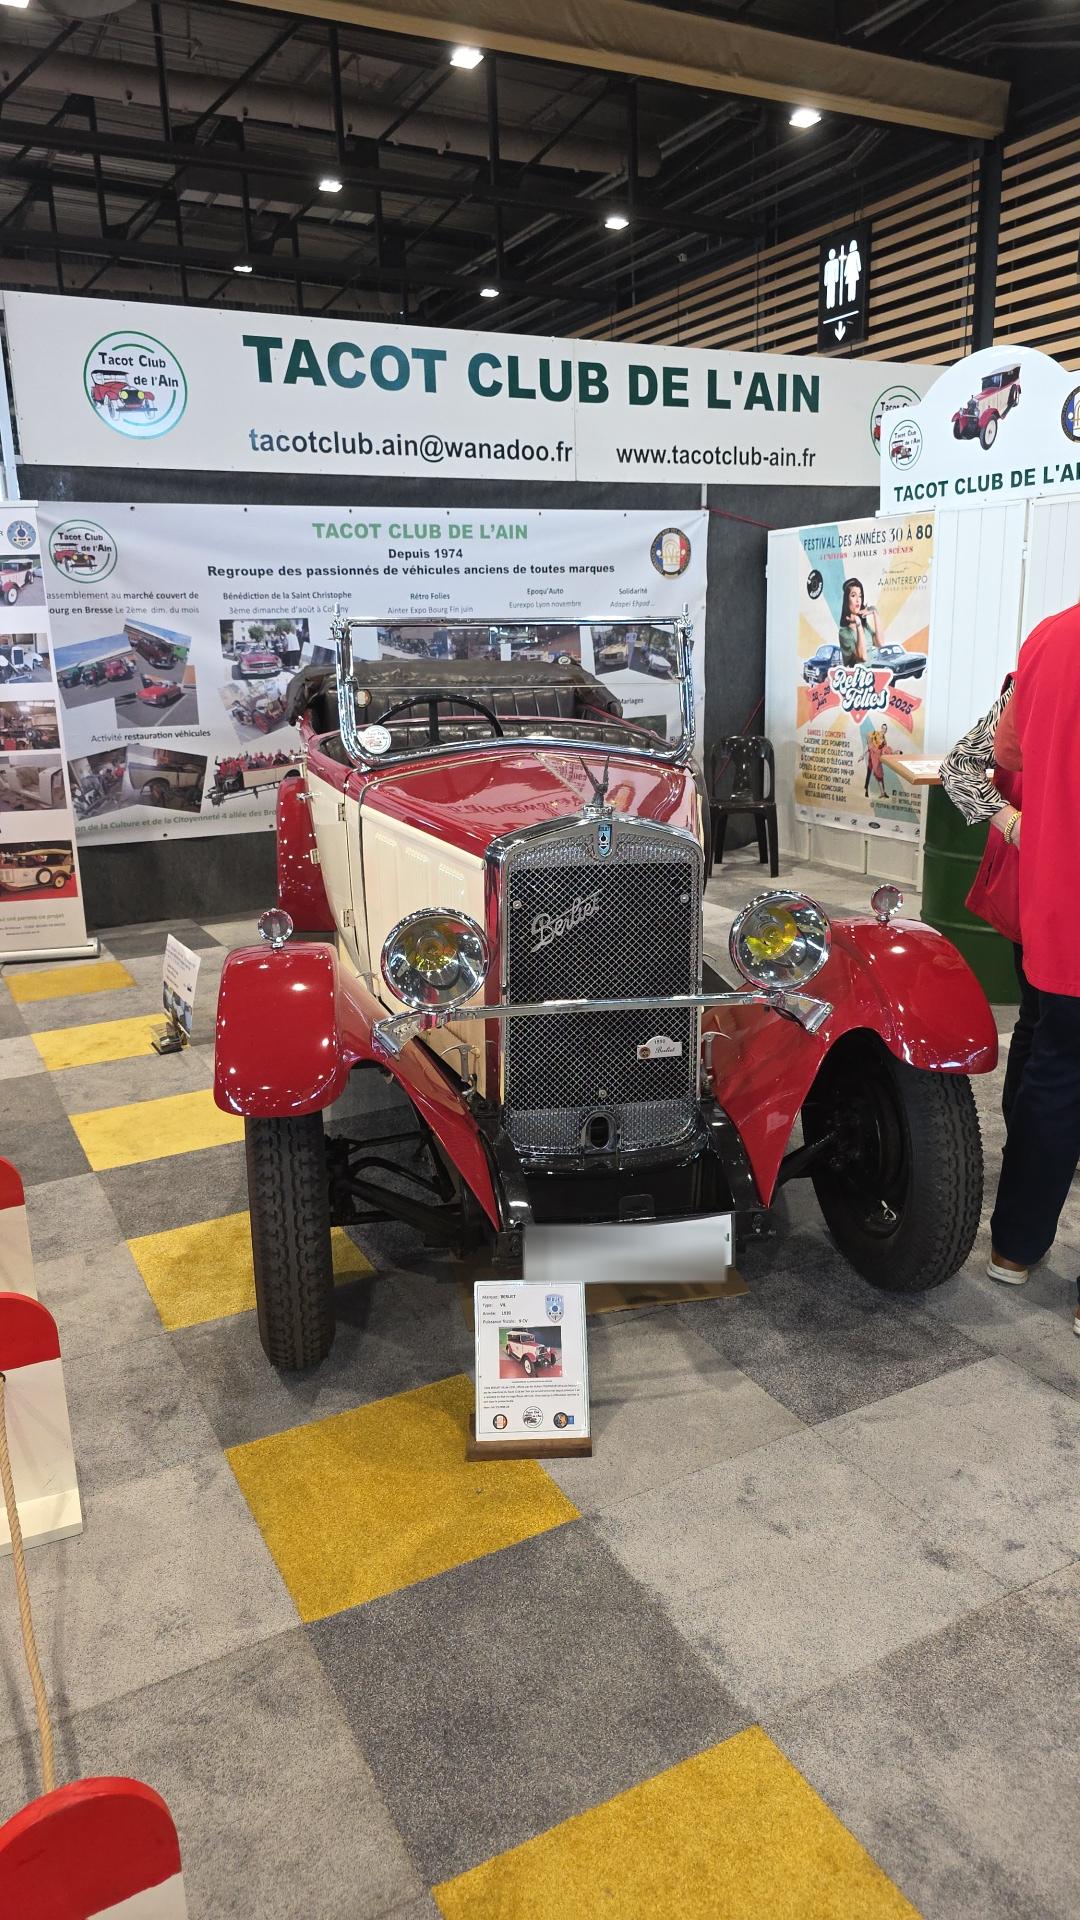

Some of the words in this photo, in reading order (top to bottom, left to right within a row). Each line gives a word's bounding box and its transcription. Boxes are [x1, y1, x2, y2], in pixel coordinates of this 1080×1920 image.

[98, 351, 133, 366] Tacot
[139, 355, 166, 368] Club
[134, 376, 148, 385] de
[242, 335, 446, 394] TACOT
[467, 352, 608, 404] CLUB
[628, 364, 689, 407] DE
[708, 369, 820, 413] L'AIN
[249, 428, 573, 464] tacotclub.ain@wanadoo.fr
[616, 443, 816, 468] www.tacotclub-ain.fr
[894, 480, 949, 502] TACOT
[954, 472, 1004, 496] CLUB
[1010, 468, 1036, 488] DE
[58, 532, 82, 540] Tacot
[312, 523, 382, 539] TACOT
[388, 524, 442, 539] CLUB
[448, 524, 474, 539] DE
[480, 524, 528, 539] L'AIN
[804, 536, 836, 551] FESTIVAL
[838, 534, 852, 548] DES
[854, 528, 887, 546] ANNÉES
[889, 528, 903, 541] 30
[906, 524, 913, 540] À
[916, 523, 932, 540] 80
[388, 549, 430, 560] Depuis
[434, 549, 463, 558] 1974
[207, 566, 274, 578] Regroupe
[278, 566, 302, 576] des
[306, 565, 379, 578] passionnés
[384, 565, 398, 575] de
[402, 564, 460, 575] véhicules
[464, 565, 510, 574] anciens
[513, 564, 526, 574] de
[530, 564, 566, 574] toutes
[568, 565, 615, 576] marques
[124, 591, 154, 600] marché
[188, 592, 199, 600] de
[222, 592, 269, 600] Bénédiction
[312, 592, 352, 600] Christophe
[410, 592, 428, 600] Rétro
[430, 592, 450, 600] Folies
[252, 606, 289, 614] dimanche
[888, 695, 914, 714] 2025
[124, 732, 172, 741] restauration
[174, 730, 212, 738] véhicules
[88, 824, 98, 832] de
[100, 822, 108, 830] la
[110, 820, 140, 830] Culture
[142, 818, 151, 826] et
[152, 818, 162, 826] de
[164, 816, 172, 824] la
[174, 813, 220, 826] Citoyenneté
[228, 811, 248, 820] allée
[249, 810, 262, 818] des
[530, 889, 603, 953] Berliet
